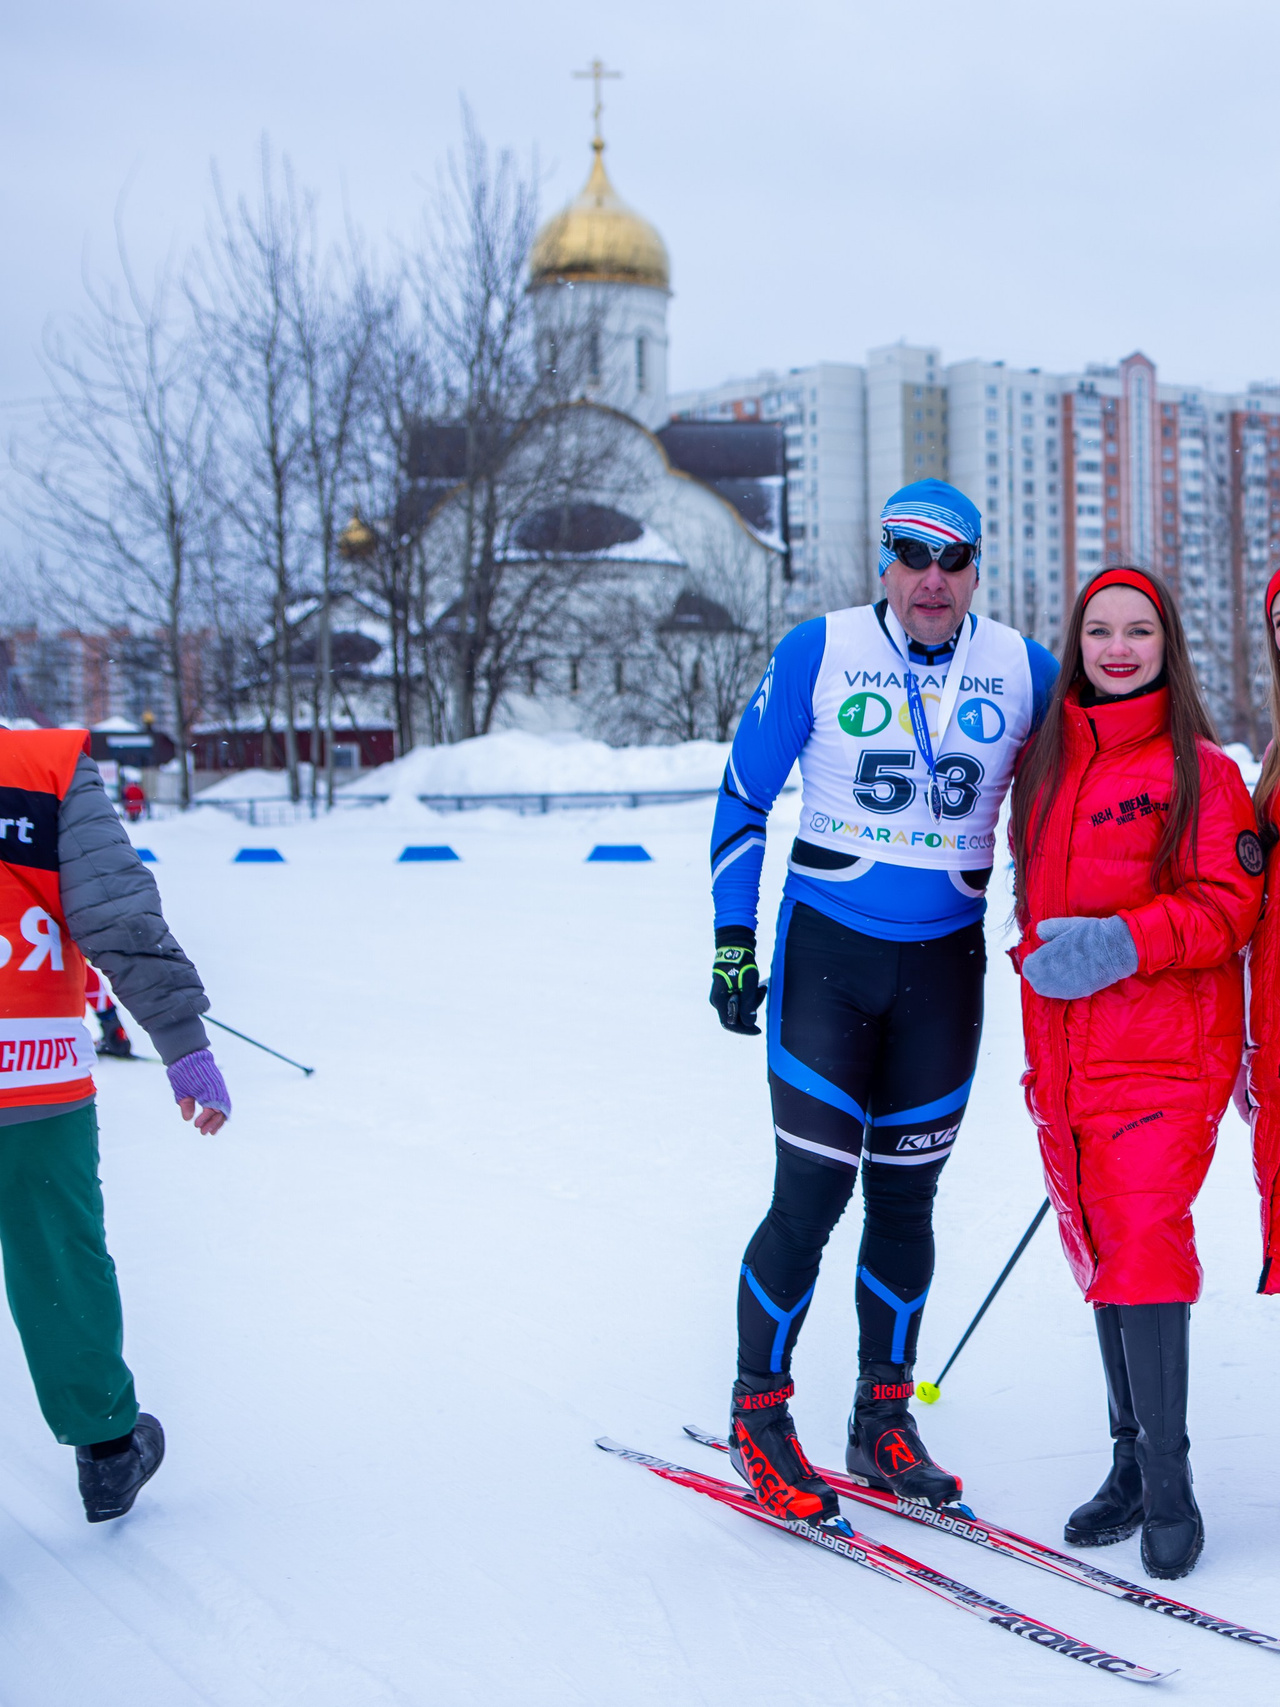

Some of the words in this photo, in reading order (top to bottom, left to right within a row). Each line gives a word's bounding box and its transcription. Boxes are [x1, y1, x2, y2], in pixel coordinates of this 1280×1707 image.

[853, 750, 984, 820] 53
[0, 816, 34, 844] rt
[1091, 807, 1113, 827] H&H
[1119, 793, 1151, 814] DREAM
[0, 1037, 78, 1073] СПОРТ
[1124, 1121, 1139, 1131] LOVE
[783, 1519, 868, 1562] WORLDCUP
[896, 1499, 989, 1543] WORLDCUP
[1120, 1592, 1279, 1646] ATOMIC
[988, 1615, 1138, 1673] ATOMIC
